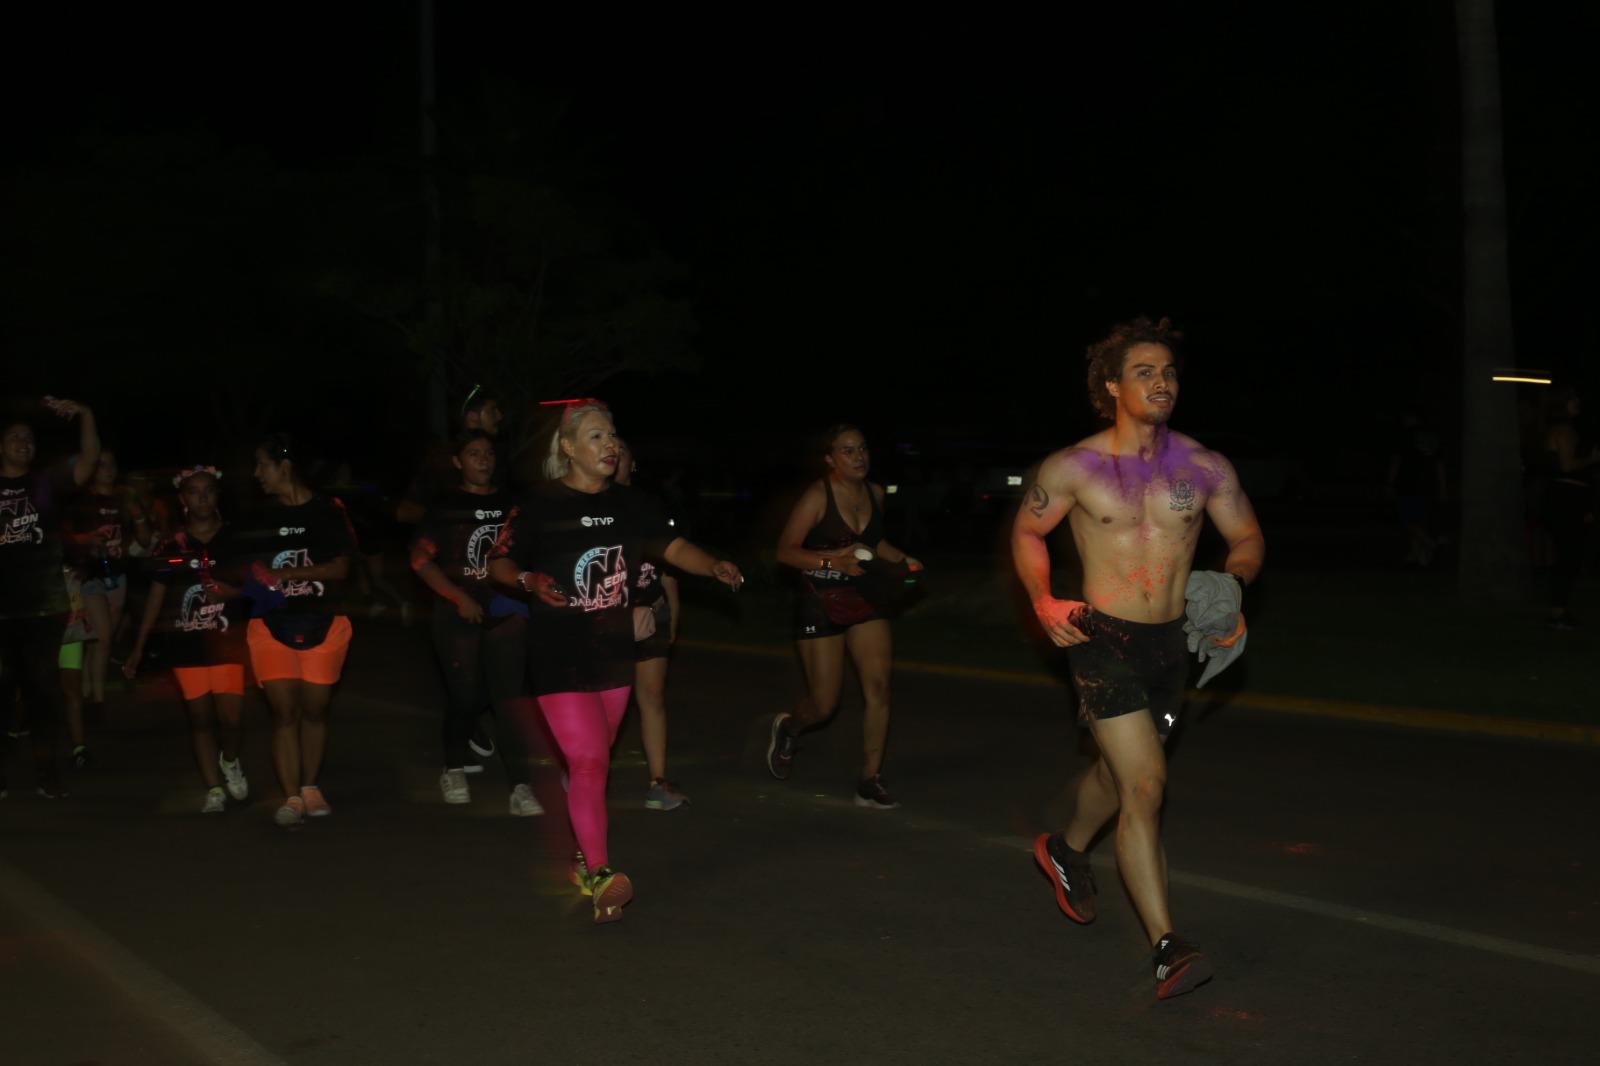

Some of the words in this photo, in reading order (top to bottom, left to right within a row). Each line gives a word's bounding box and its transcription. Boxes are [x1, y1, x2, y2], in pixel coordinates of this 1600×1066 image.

[484, 510, 502, 519] TVP
[591, 517, 615, 526] TVP
[288, 527, 306, 535] TVP
